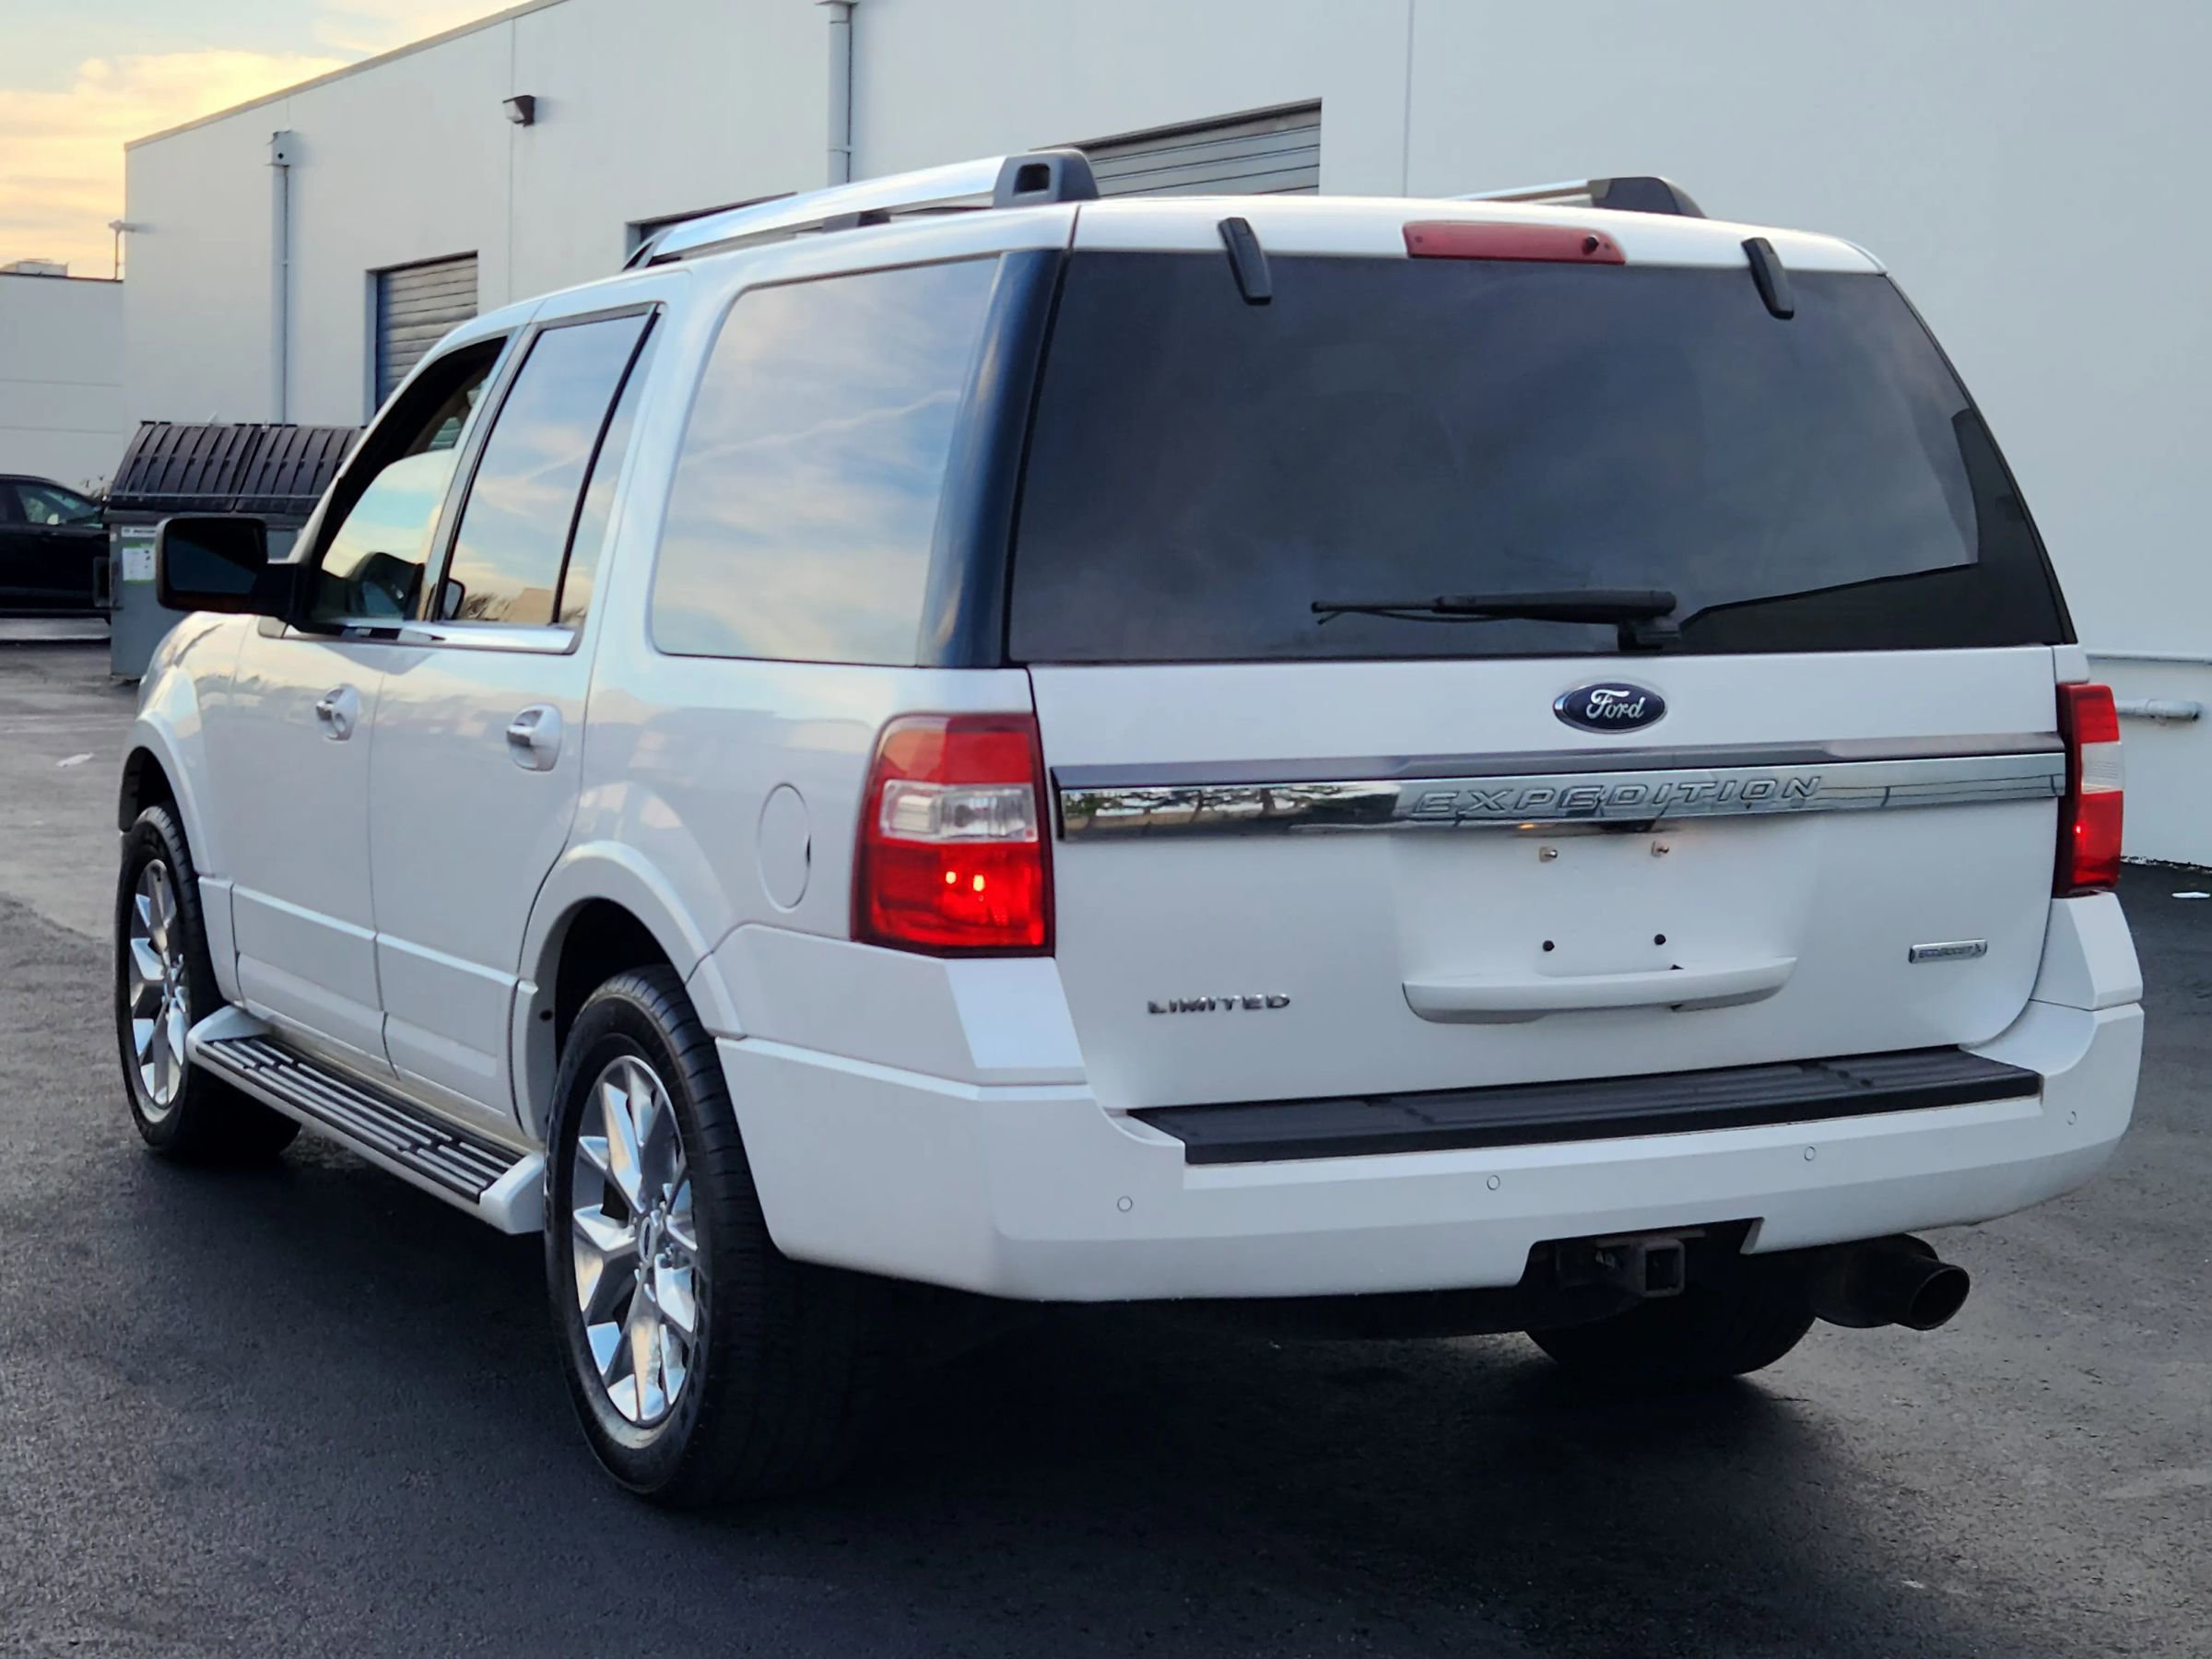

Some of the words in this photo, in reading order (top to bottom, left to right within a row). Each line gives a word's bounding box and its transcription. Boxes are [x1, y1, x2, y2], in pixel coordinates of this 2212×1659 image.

[1586, 689, 1646, 719] Ford
[1411, 775, 1822, 815] EXPEDITION
[1147, 993, 1290, 1014] LIMITED
